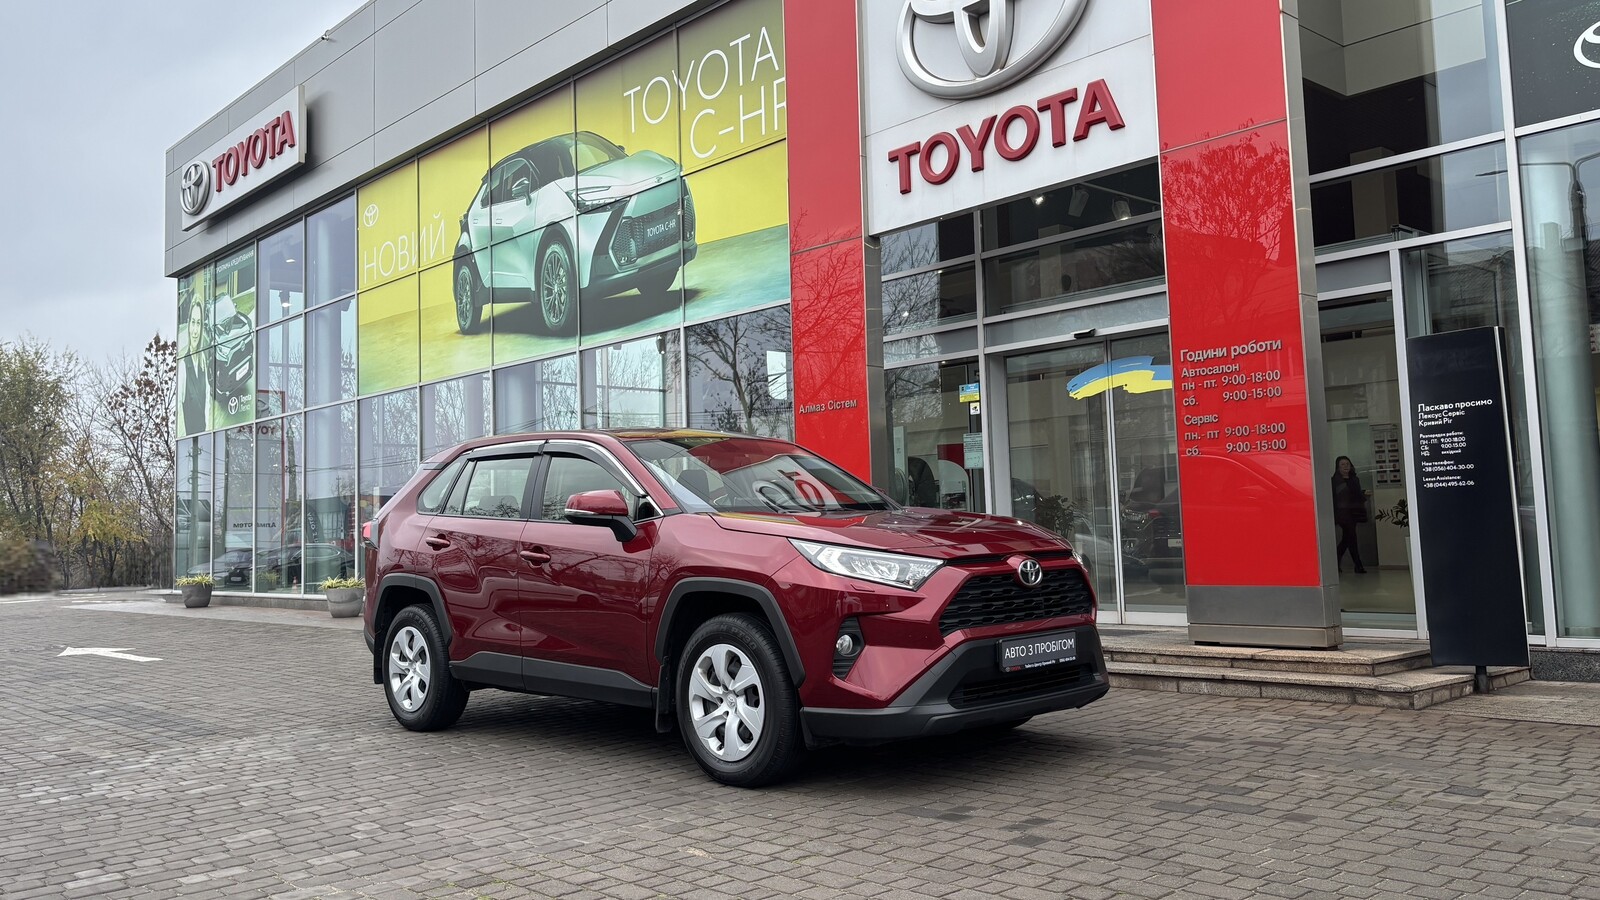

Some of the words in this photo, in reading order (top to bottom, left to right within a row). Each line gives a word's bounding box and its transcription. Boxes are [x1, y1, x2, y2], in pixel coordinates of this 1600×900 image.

[623, 26, 779, 133] TOYOTA
[887, 78, 1126, 195] TOYOTA
[212, 110, 295, 192] TOYOTA
[647, 223, 664, 238] TOYOTA
[665, 218, 677, 231] C-HR
[364, 212, 445, 284] НОВИЙ
[1180, 346, 1227, 362] Години
[1231, 340, 1282, 359] роботи
[1182, 363, 1240, 378] Автосалон
[1222, 370, 1281, 386] 9:00-18:00
[1183, 395, 1198, 406] сб.
[1223, 386, 1282, 402] 9:00-15:00
[799, 403, 826, 415] Алмаз
[827, 399, 857, 410] Сістем
[1418, 403, 1453, 412] Ласкаво
[1455, 399, 1493, 409] просимо
[1184, 414, 1218, 426] Сервіс
[1418, 419, 1442, 427] Кривий
[1225, 422, 1285, 437] 9:00-18:00
[1186, 445, 1202, 456] сб.
[1226, 439, 1287, 453] 9:00-15:00
[1004, 645, 1027, 659] АВТО
[1028, 644, 1033, 656] З
[1034, 638, 1075, 655] ПРОБІГОМ
